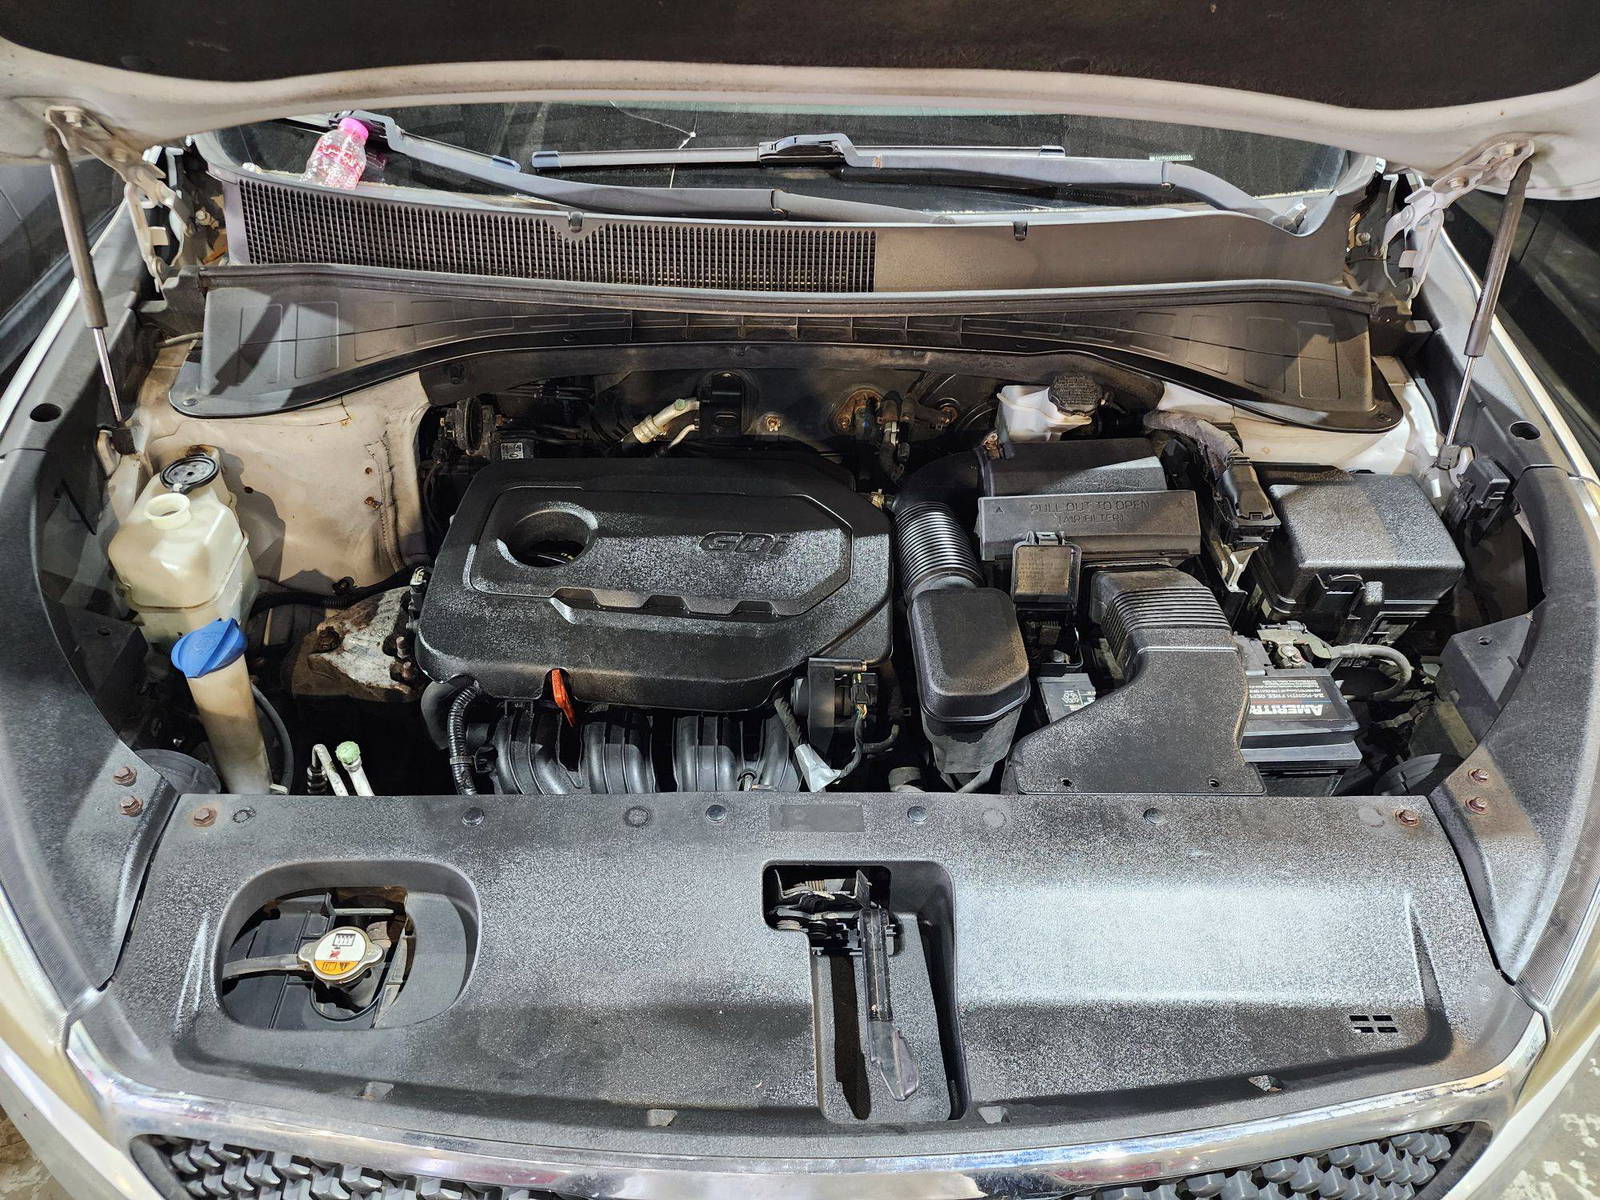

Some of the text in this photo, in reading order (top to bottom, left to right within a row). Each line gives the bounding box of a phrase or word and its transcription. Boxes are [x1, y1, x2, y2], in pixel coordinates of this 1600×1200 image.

[1030, 500, 1150, 512] PULL OUT TO OPEN
